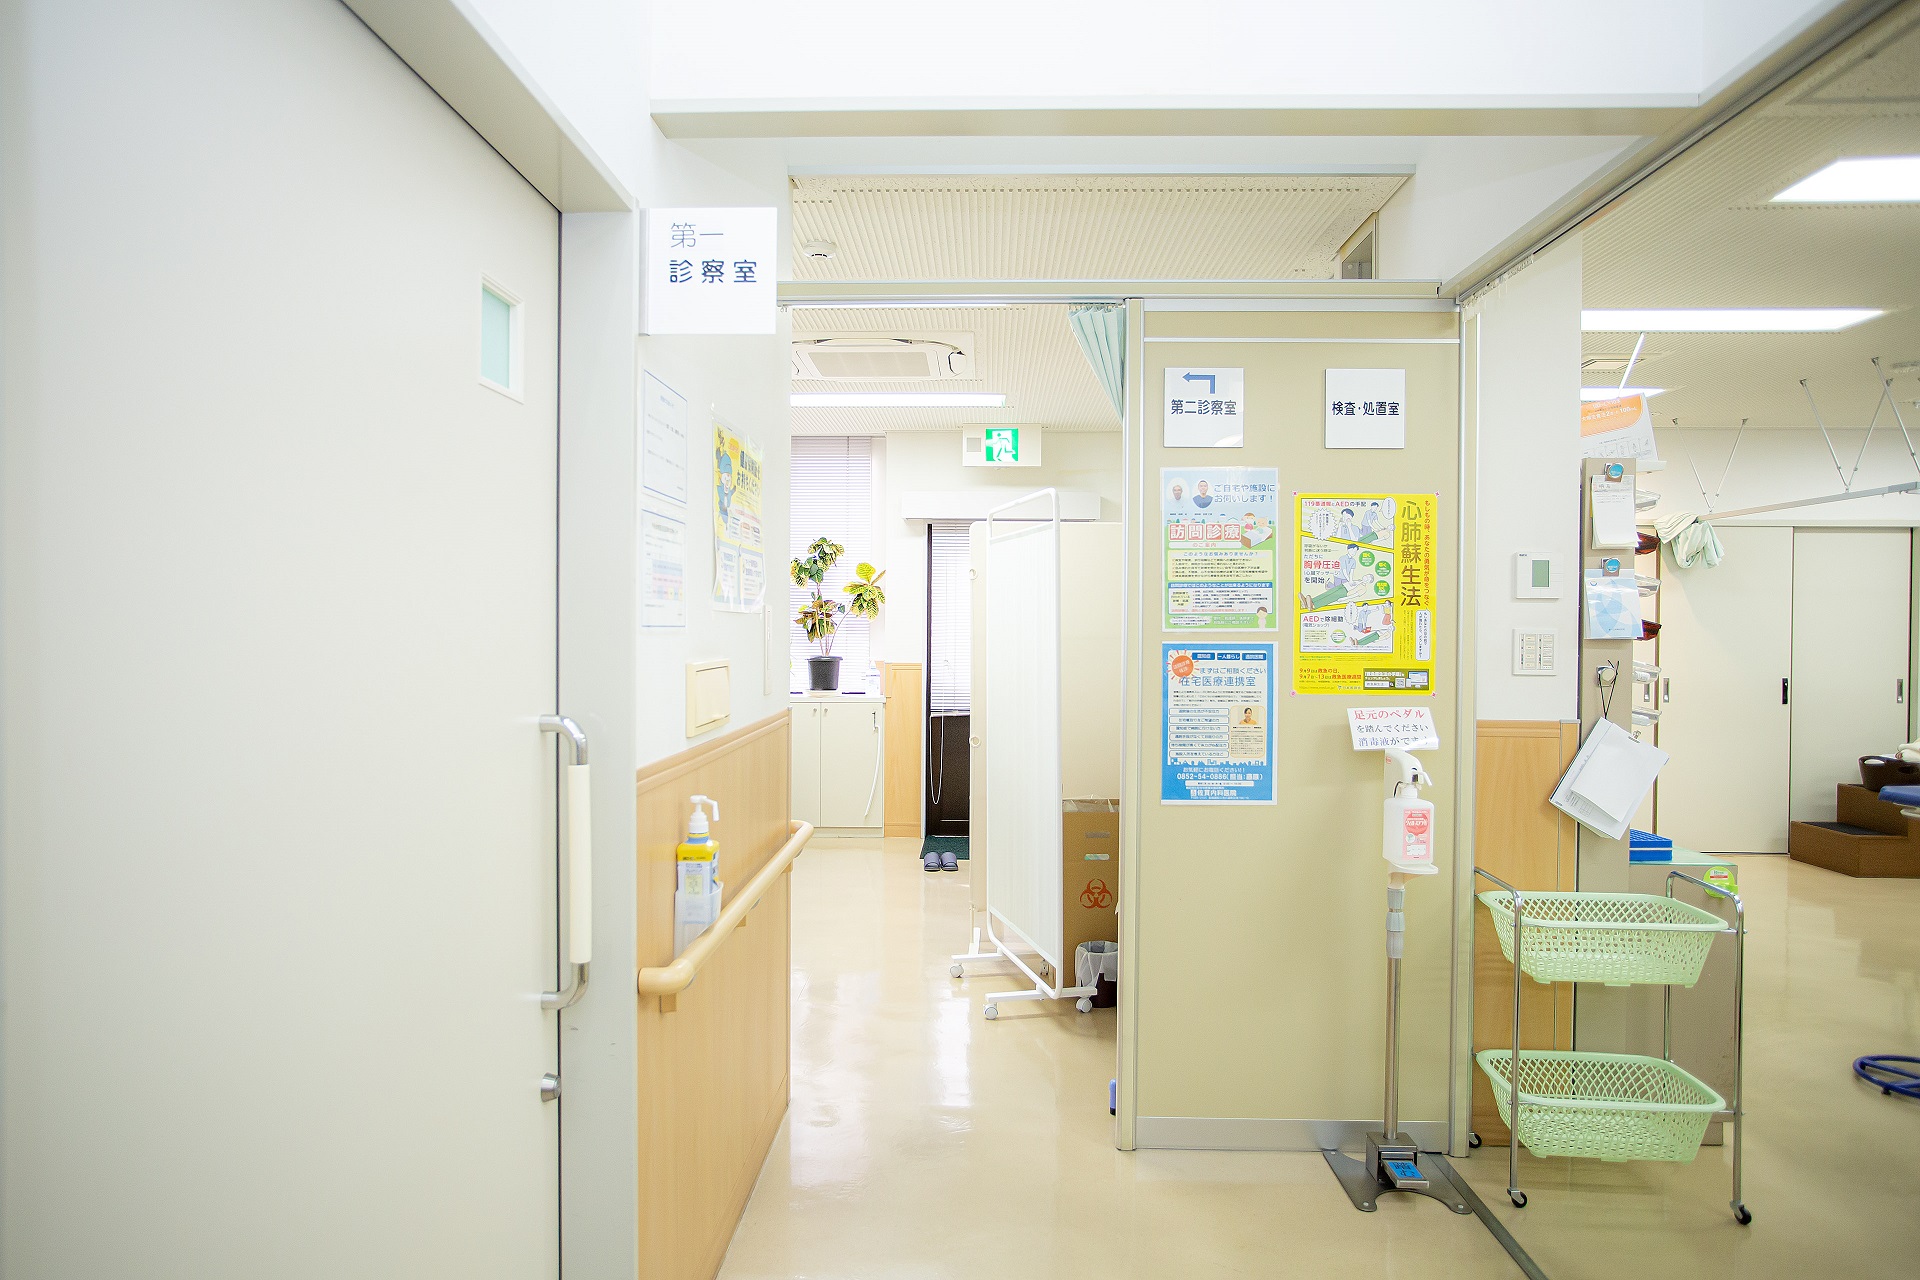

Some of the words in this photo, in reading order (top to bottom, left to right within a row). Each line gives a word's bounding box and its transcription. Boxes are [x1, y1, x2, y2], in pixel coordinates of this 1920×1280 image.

[670, 222, 724, 249] 第一
[669, 259, 757, 284] 診察室
[1171, 399, 1237, 416] 第二診察室
[1331, 401, 1400, 416] 検査・処置室
[1214, 484, 1276, 493] ご自宅や施設に
[1169, 524, 1241, 541] 訪問診療
[1401, 500, 1422, 607] 心肺蘇生法
[1303, 560, 1341, 570] 胸骨圧迫
[1199, 667, 1267, 675] まずはご相談ください
[1180, 676, 1256, 687] 在宅医療連携室
[1353, 708, 1425, 720] 足元のペダル
[1356, 723, 1429, 733] を踏んでください
